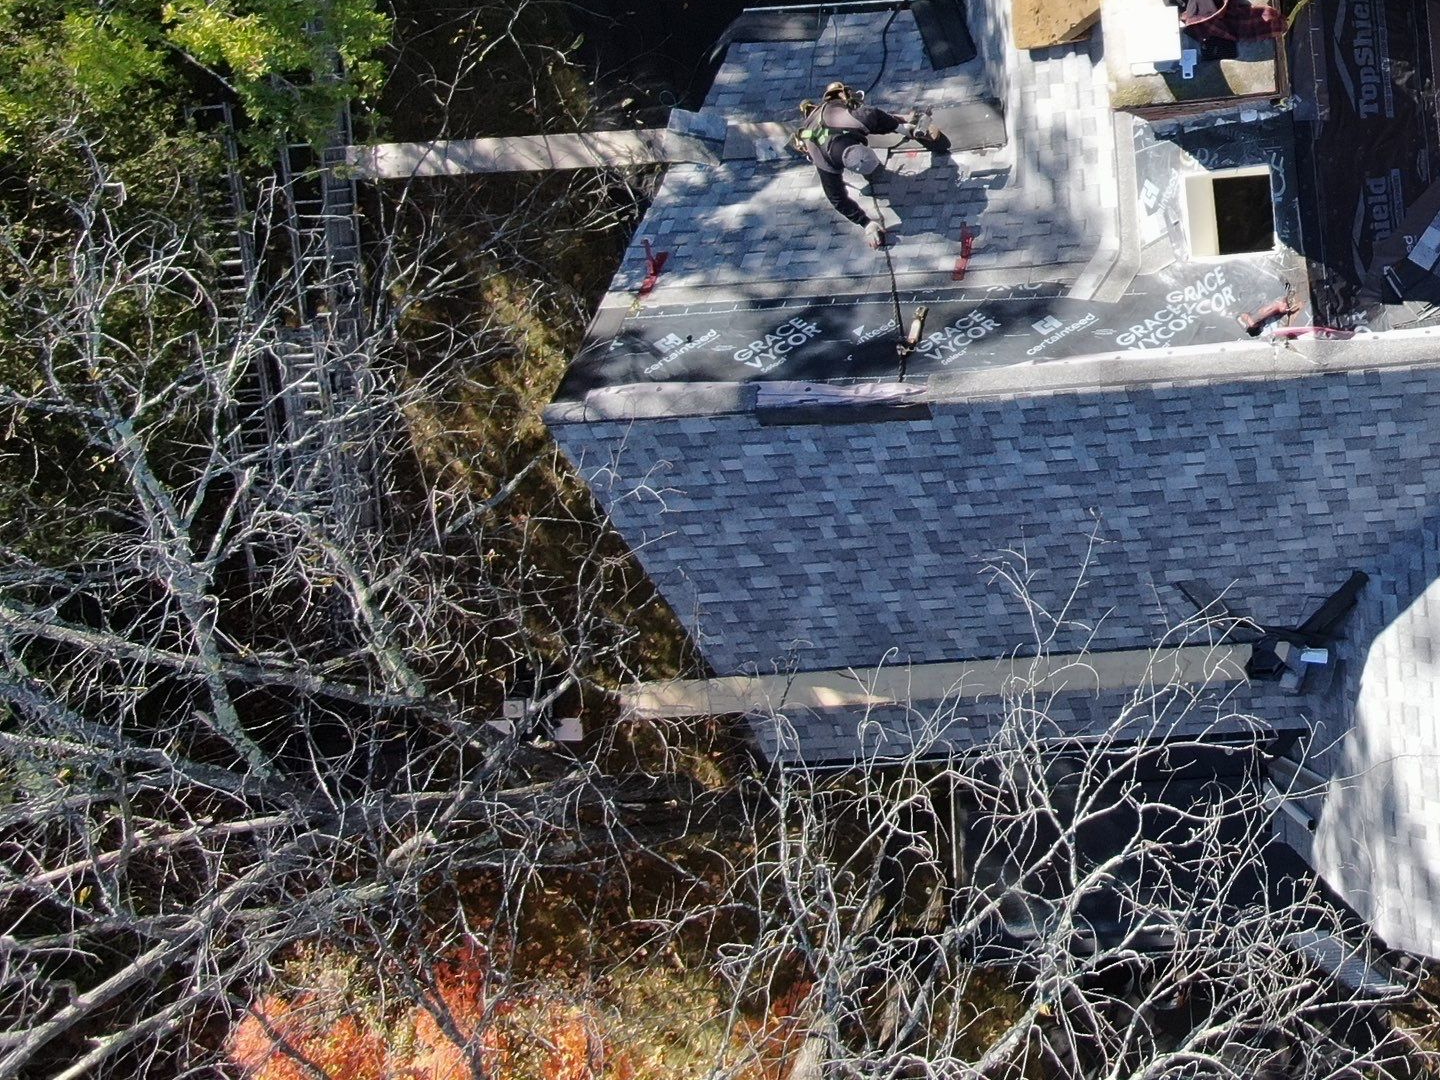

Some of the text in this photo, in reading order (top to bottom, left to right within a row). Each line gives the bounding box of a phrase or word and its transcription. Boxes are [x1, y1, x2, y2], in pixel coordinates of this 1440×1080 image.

[1165, 266, 1226, 303] GRACE
[733, 317, 808, 361] GRACE
[744, 323, 822, 368] VYCOR
[915, 309, 986, 353] GRACE
[924, 319, 1002, 360] VYCOR
[1116, 304, 1183, 346] GRACE
